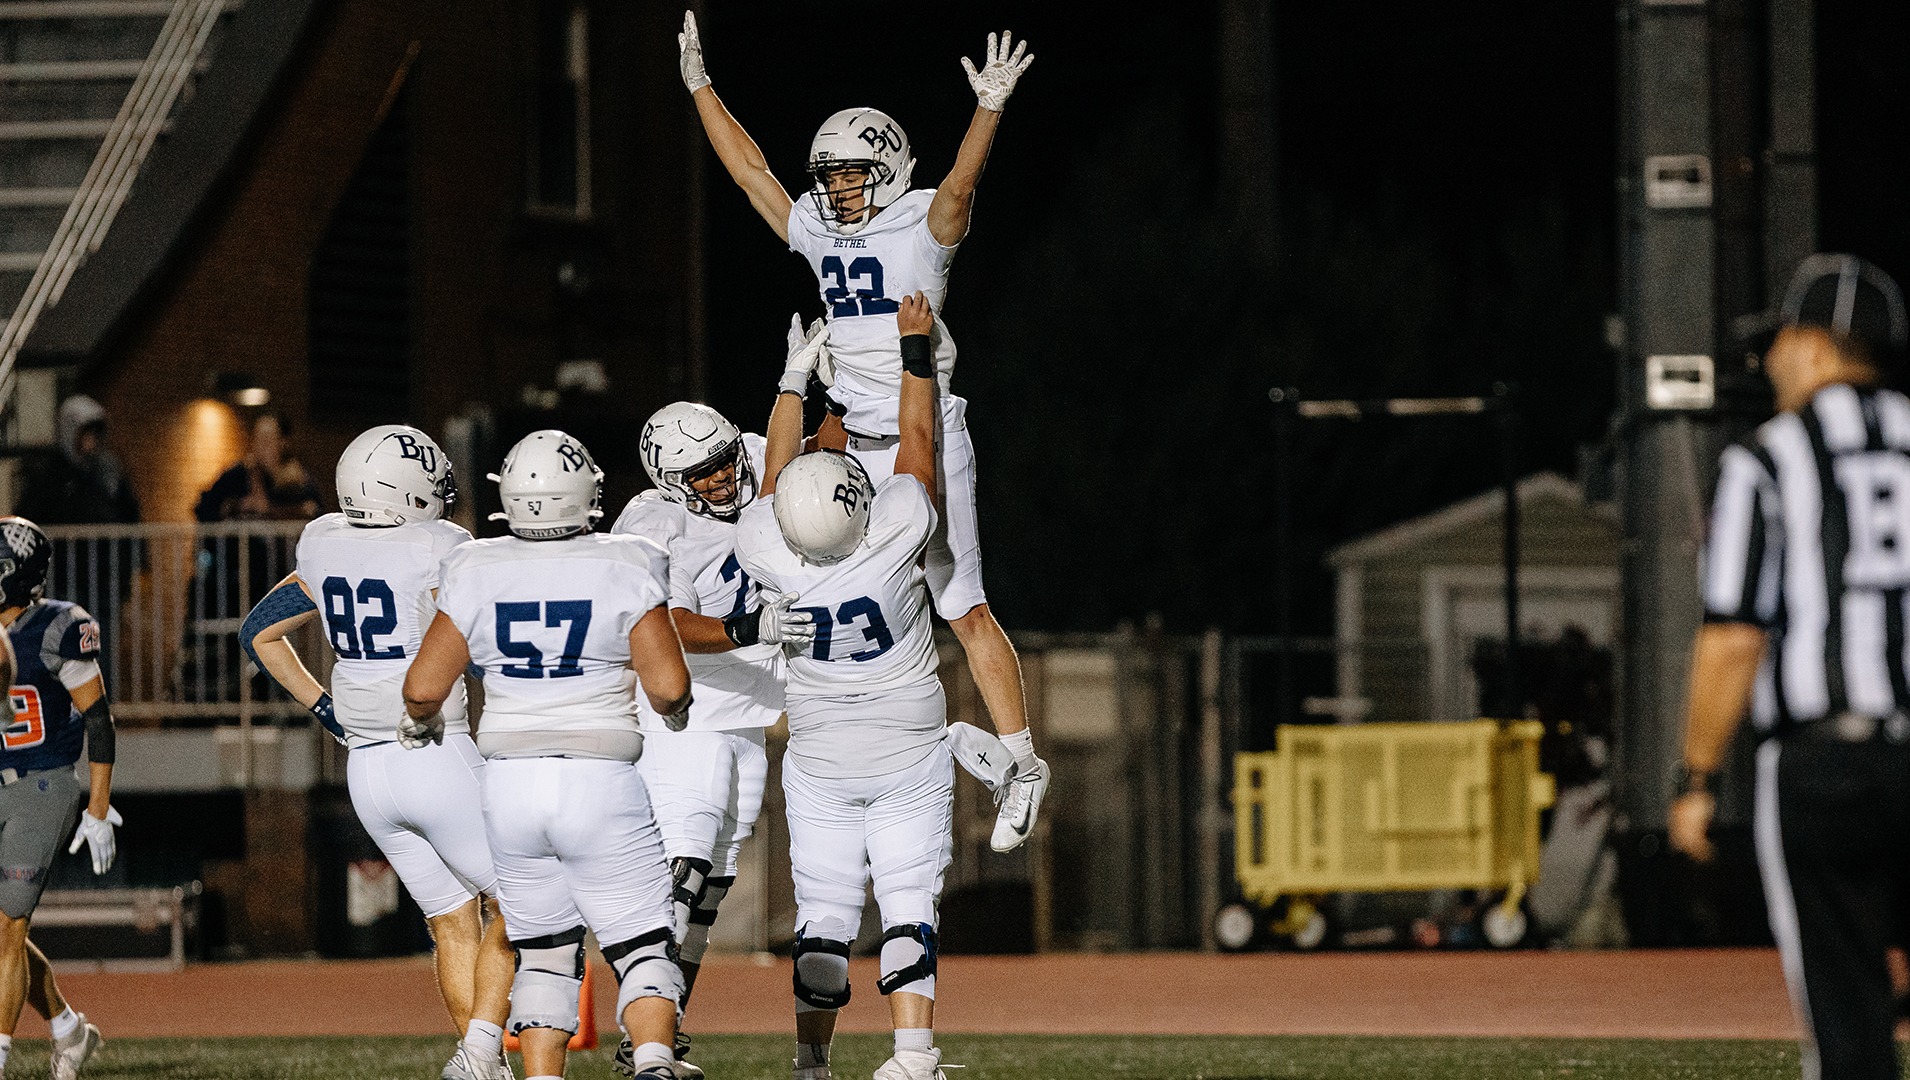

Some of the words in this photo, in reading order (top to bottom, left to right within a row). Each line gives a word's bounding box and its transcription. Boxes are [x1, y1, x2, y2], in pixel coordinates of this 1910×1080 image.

[857, 122, 903, 153] BU
[833, 238, 867, 249] BETHEL
[821, 255, 900, 318] 22
[394, 434, 437, 473] BU
[641, 421, 662, 470] BU
[528, 501, 542, 511] 57
[322, 576, 406, 660] 82
[495, 599, 593, 679] 57
[790, 595, 895, 663] 73
